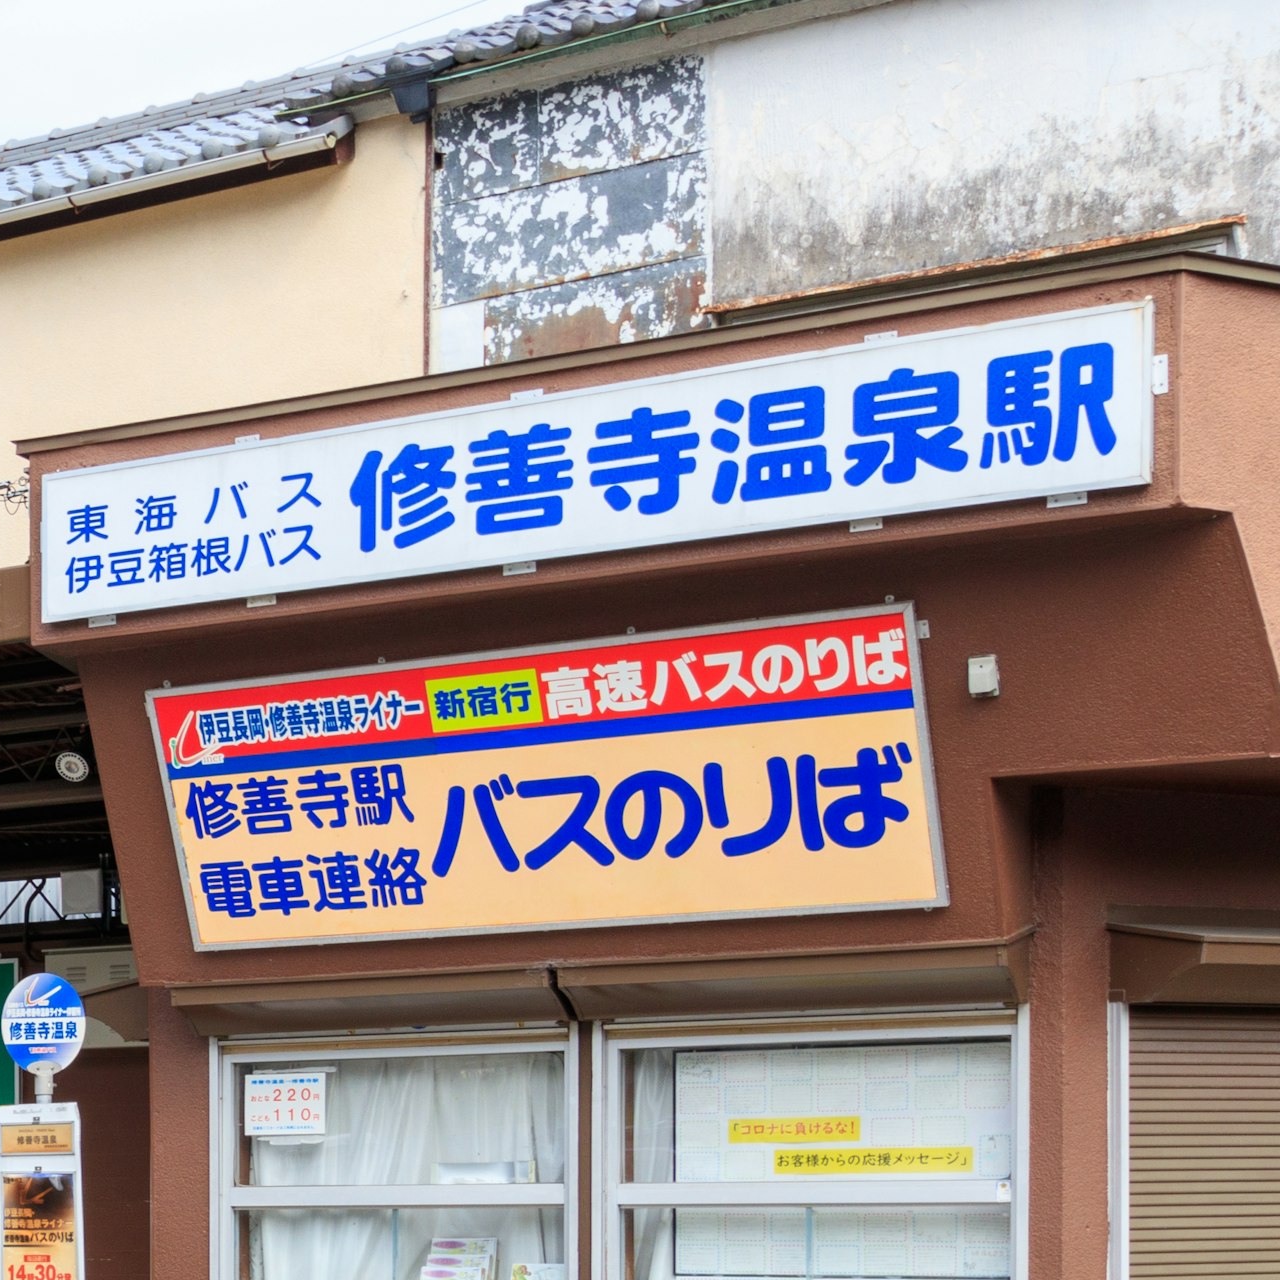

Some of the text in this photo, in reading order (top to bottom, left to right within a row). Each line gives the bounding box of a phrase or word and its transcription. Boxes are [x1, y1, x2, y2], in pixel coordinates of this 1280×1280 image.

[348, 341, 1118, 554] 修善寺温泉駅
[66, 472, 322, 545] 東海バス
[65, 524, 322, 594] 伊豆箱根バス
[197, 628, 907, 747] 伊豆長岡・修善寺温泉ライナー 新宿行 高速バスのりば
[185, 764, 414, 839] 修善寺駅
[432, 742, 912, 878] バスのりば
[200, 847, 427, 918] 電車連絡
[8, 1020, 78, 1040] 修善寺温泉
[732, 1119, 856, 1137] 「コロナに負けるな!
[776, 1151, 969, 1169] お客様からの応援メッセージ」
